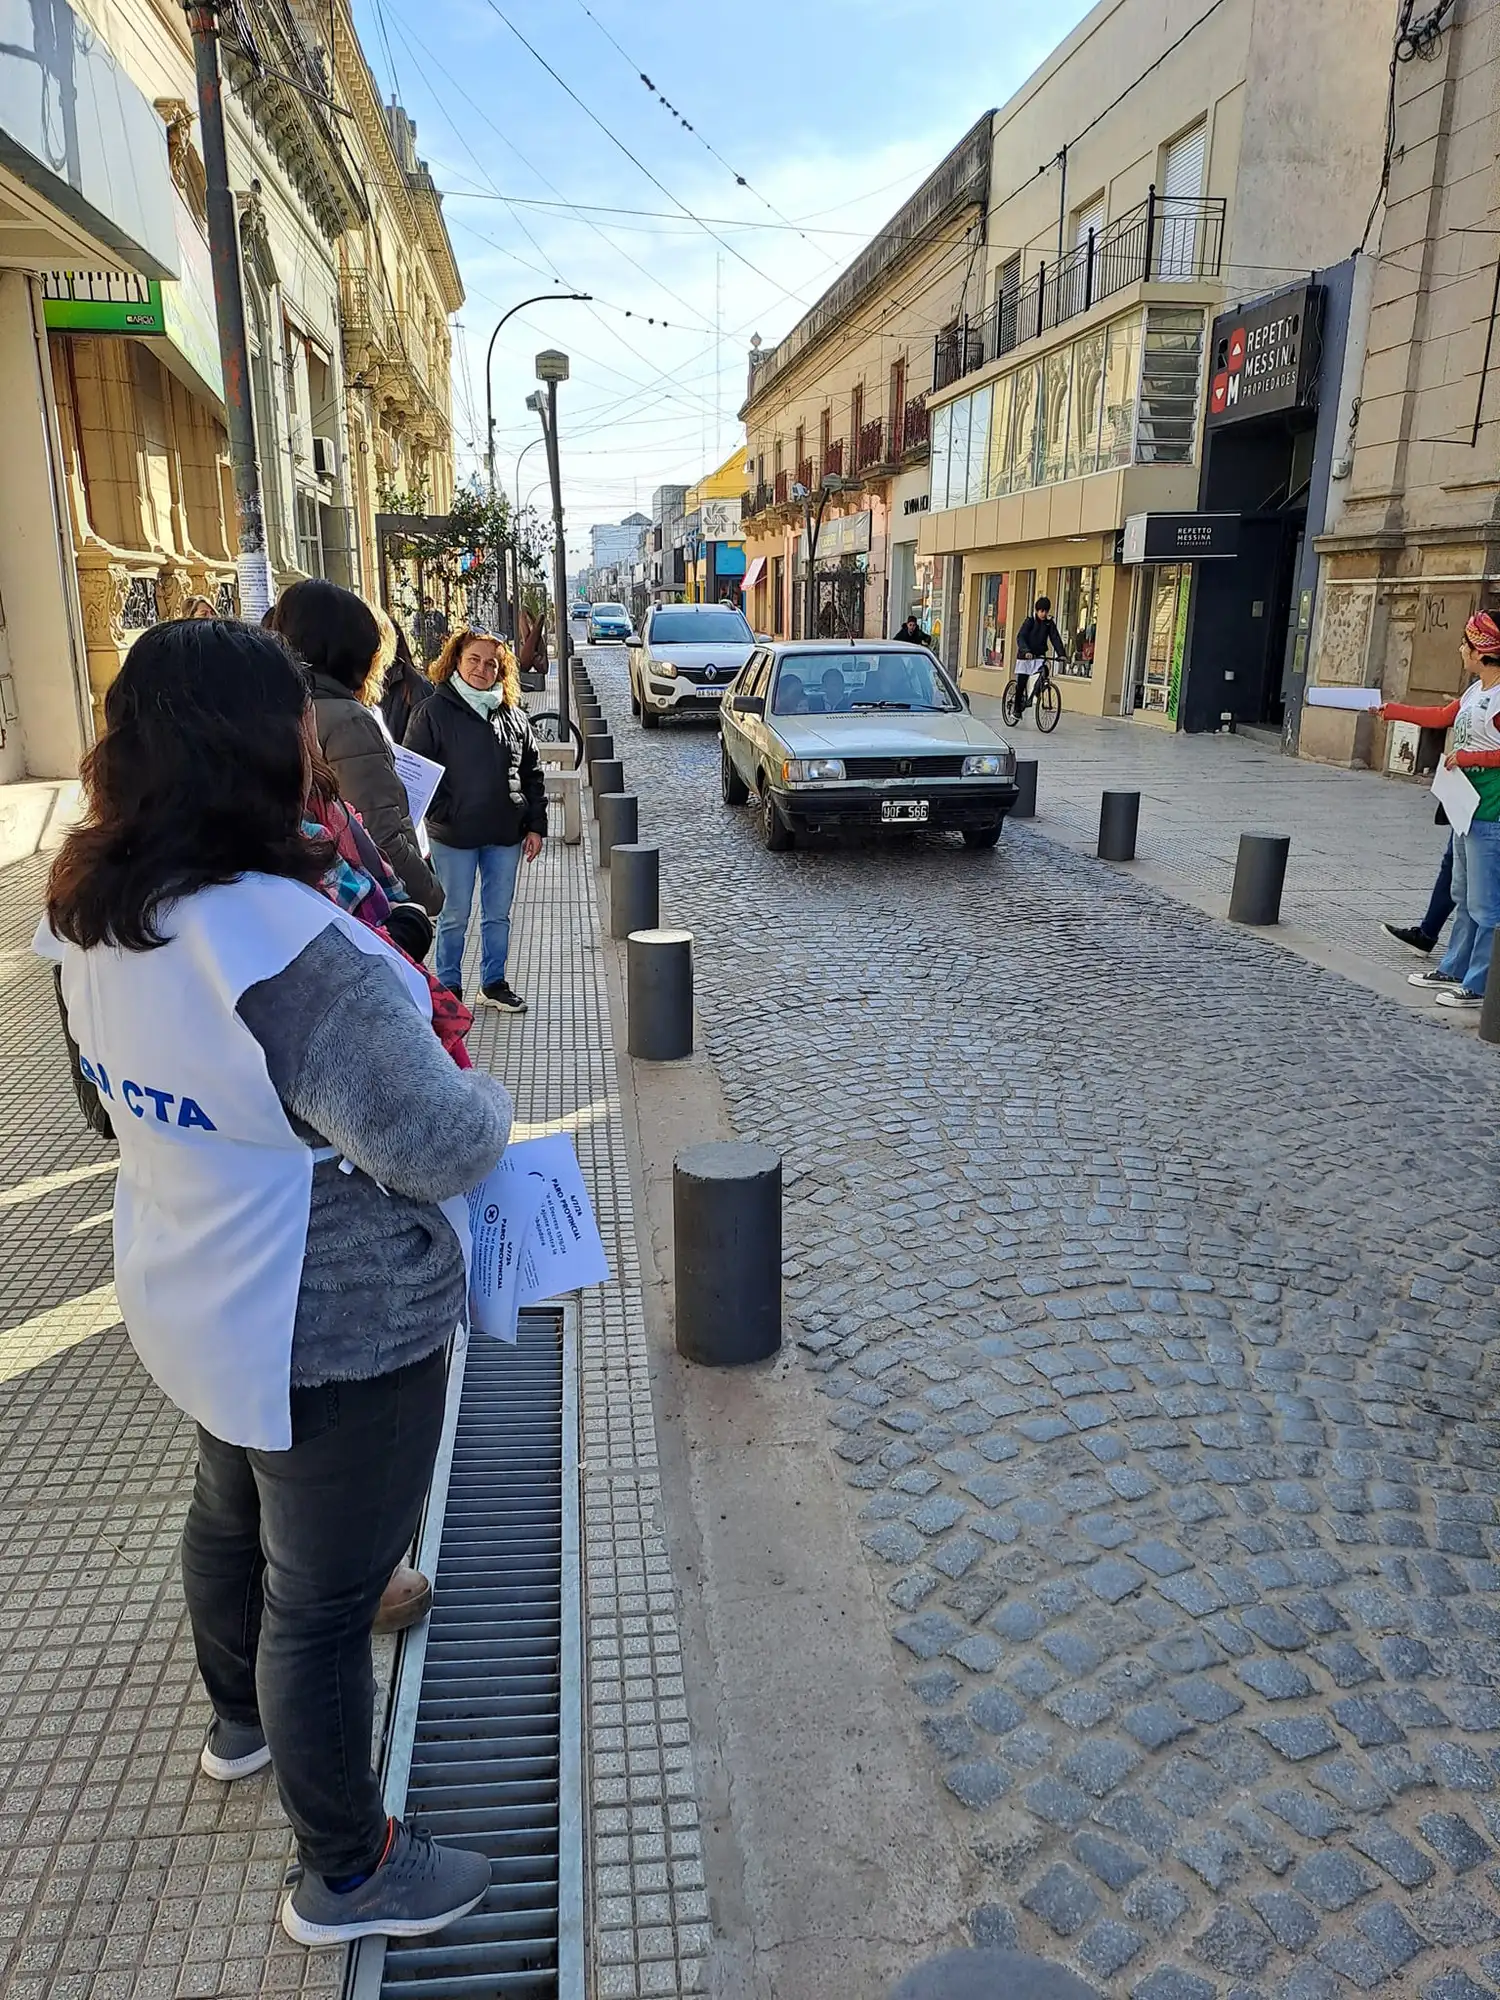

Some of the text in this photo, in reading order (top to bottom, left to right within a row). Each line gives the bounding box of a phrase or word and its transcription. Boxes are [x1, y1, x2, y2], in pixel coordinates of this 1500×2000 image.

[1247, 314, 1300, 352] REPETTO
[1244, 344, 1297, 379] MESSINA
[1242, 371, 1297, 399] PROPIEDADES
[908, 806, 928, 818] 566
[122, 1079, 218, 1132] CTA
[551, 1178, 581, 1241] PARO PROVINCIAL
